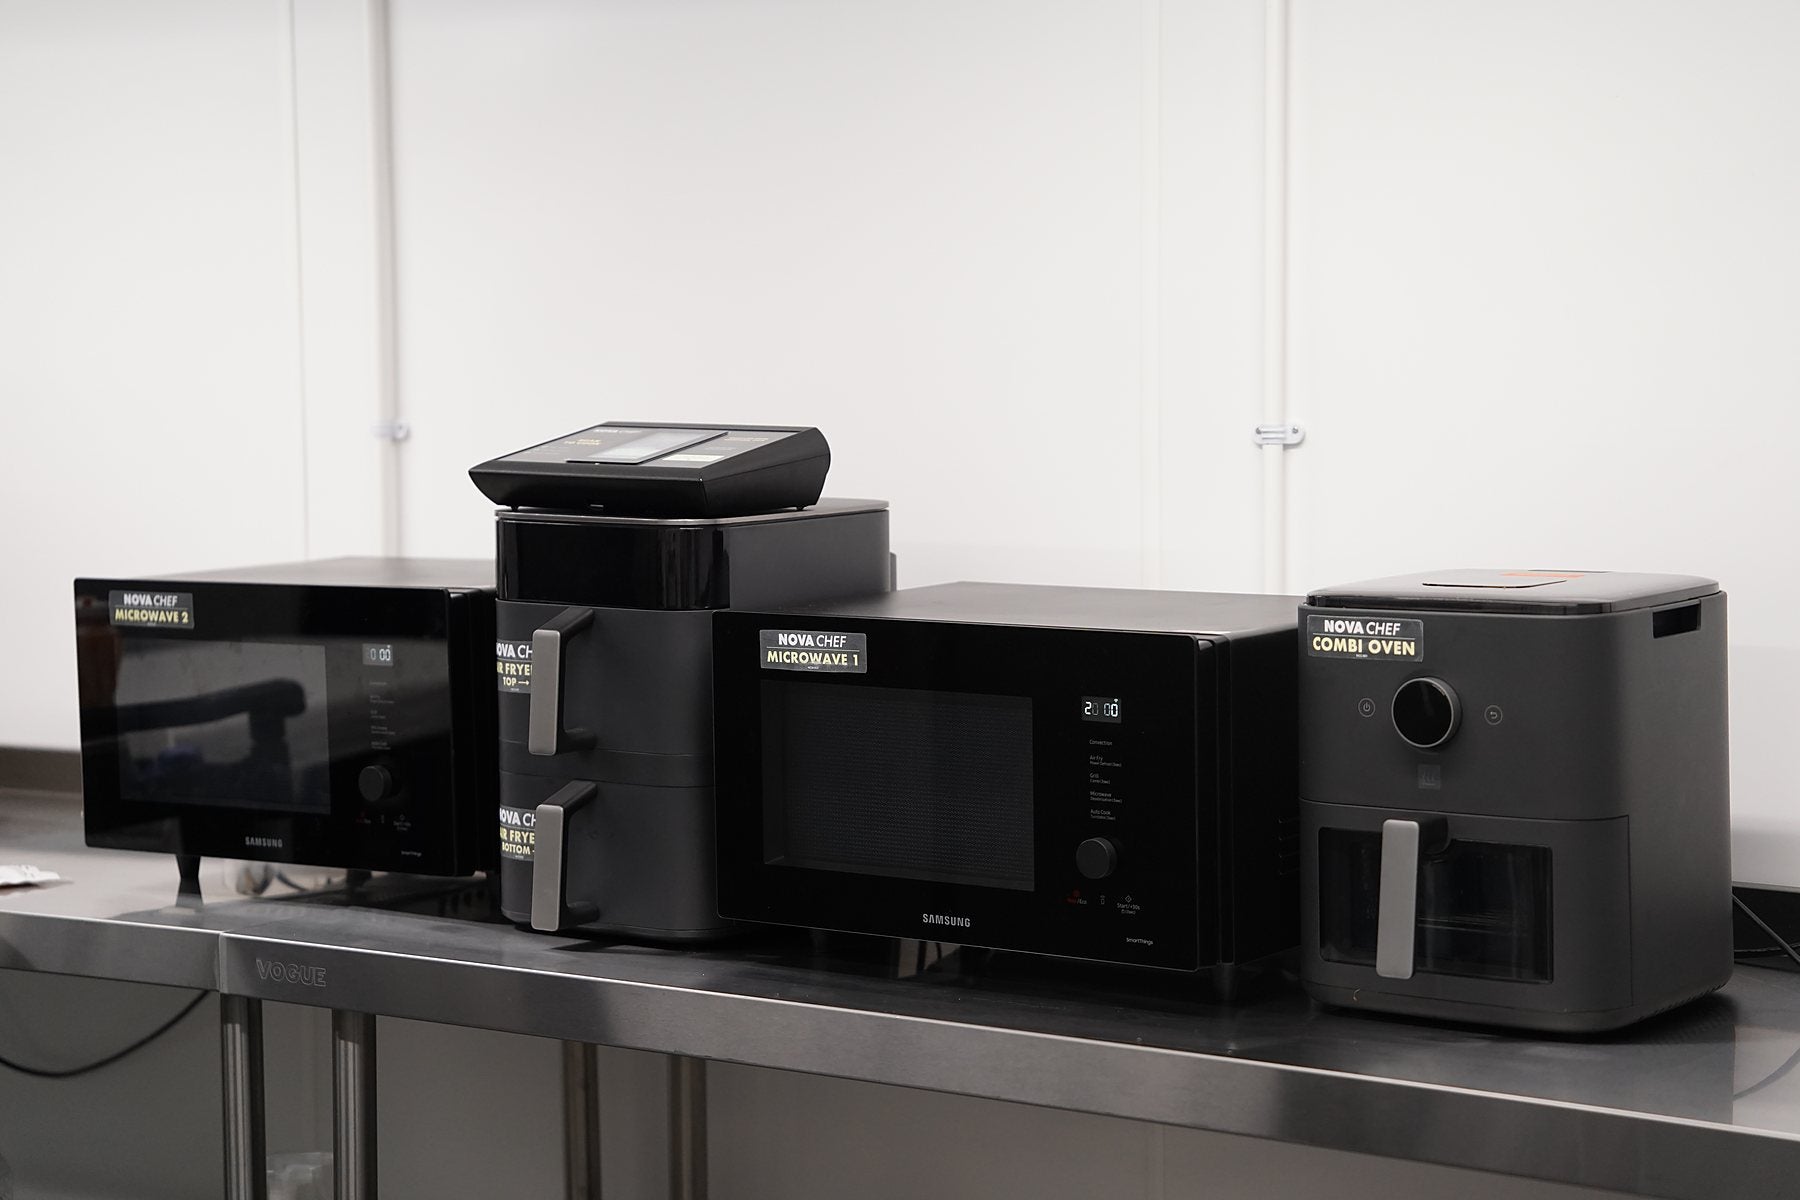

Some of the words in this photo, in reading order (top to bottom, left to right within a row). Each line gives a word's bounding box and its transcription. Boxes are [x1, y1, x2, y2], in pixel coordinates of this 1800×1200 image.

[124, 593, 152, 606] NOVA
[153, 595, 178, 606] CHEF
[115, 608, 179, 624] MICROWAVE
[181, 611, 189, 624] 2
[1324, 619, 1364, 635] NOVA
[1366, 622, 1401, 636] CHEF
[778, 633, 815, 647] NOVA
[816, 634, 847, 648] CHEF
[1312, 636, 1363, 653] COMBI
[1368, 639, 1415, 656] OVEN
[496, 642, 516, 658] OVA
[517, 644, 533, 658] CH
[767, 650, 848, 666] MICROWAVE
[853, 654, 859, 667] 1
[505, 662, 533, 676] FRYE
[503, 676, 517, 687] TOP
[522, 812, 537, 827] CH
[245, 836, 283, 848] SAMSUNG
[509, 829, 535, 845] FRYE
[922, 914, 970, 927] SAMSUNG
[255, 957, 328, 988] VOGUE
